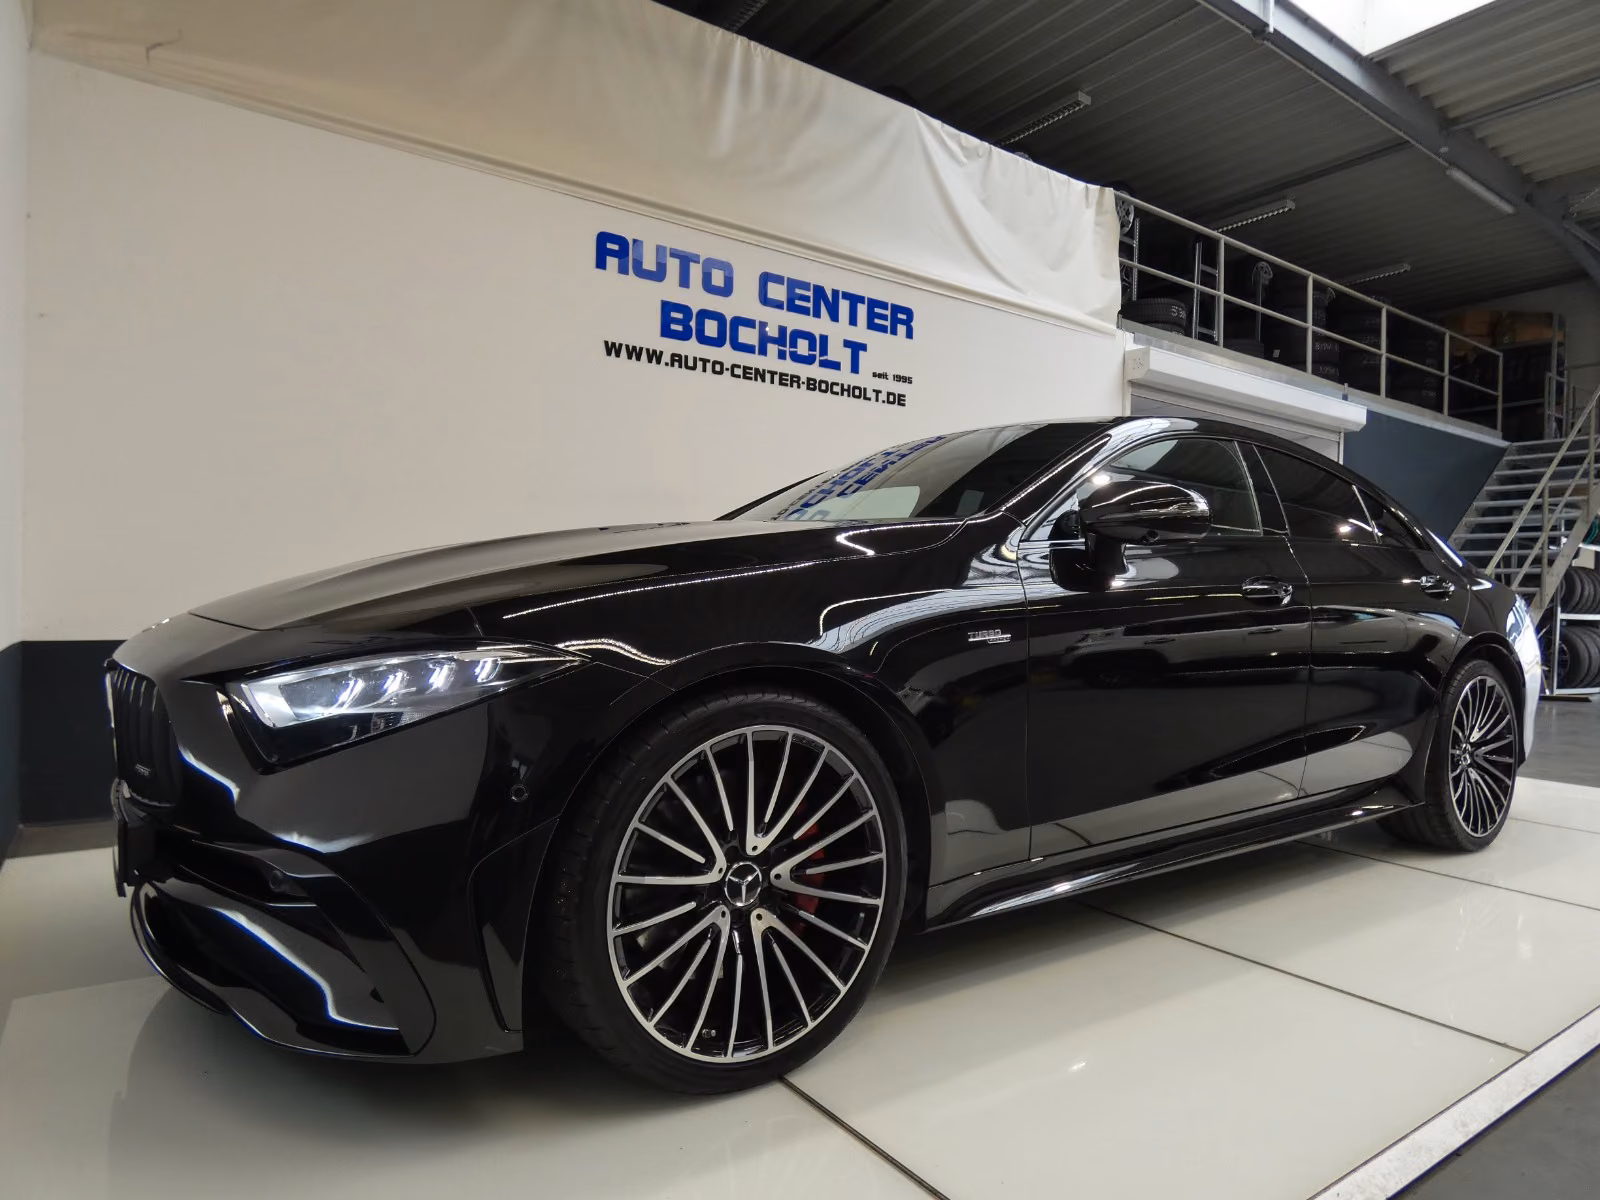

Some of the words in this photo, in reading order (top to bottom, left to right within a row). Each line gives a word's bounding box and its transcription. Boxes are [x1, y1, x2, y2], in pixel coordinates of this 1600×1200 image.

[595, 231, 734, 298] AUTO
[758, 271, 914, 340] CENTER
[660, 299, 868, 374] BOCHOLT
[604, 340, 906, 407] WWW.AUTO-CENTER-BOCHOLT.DE
[872, 371, 889, 380] seit
[893, 374, 912, 384] 1995
